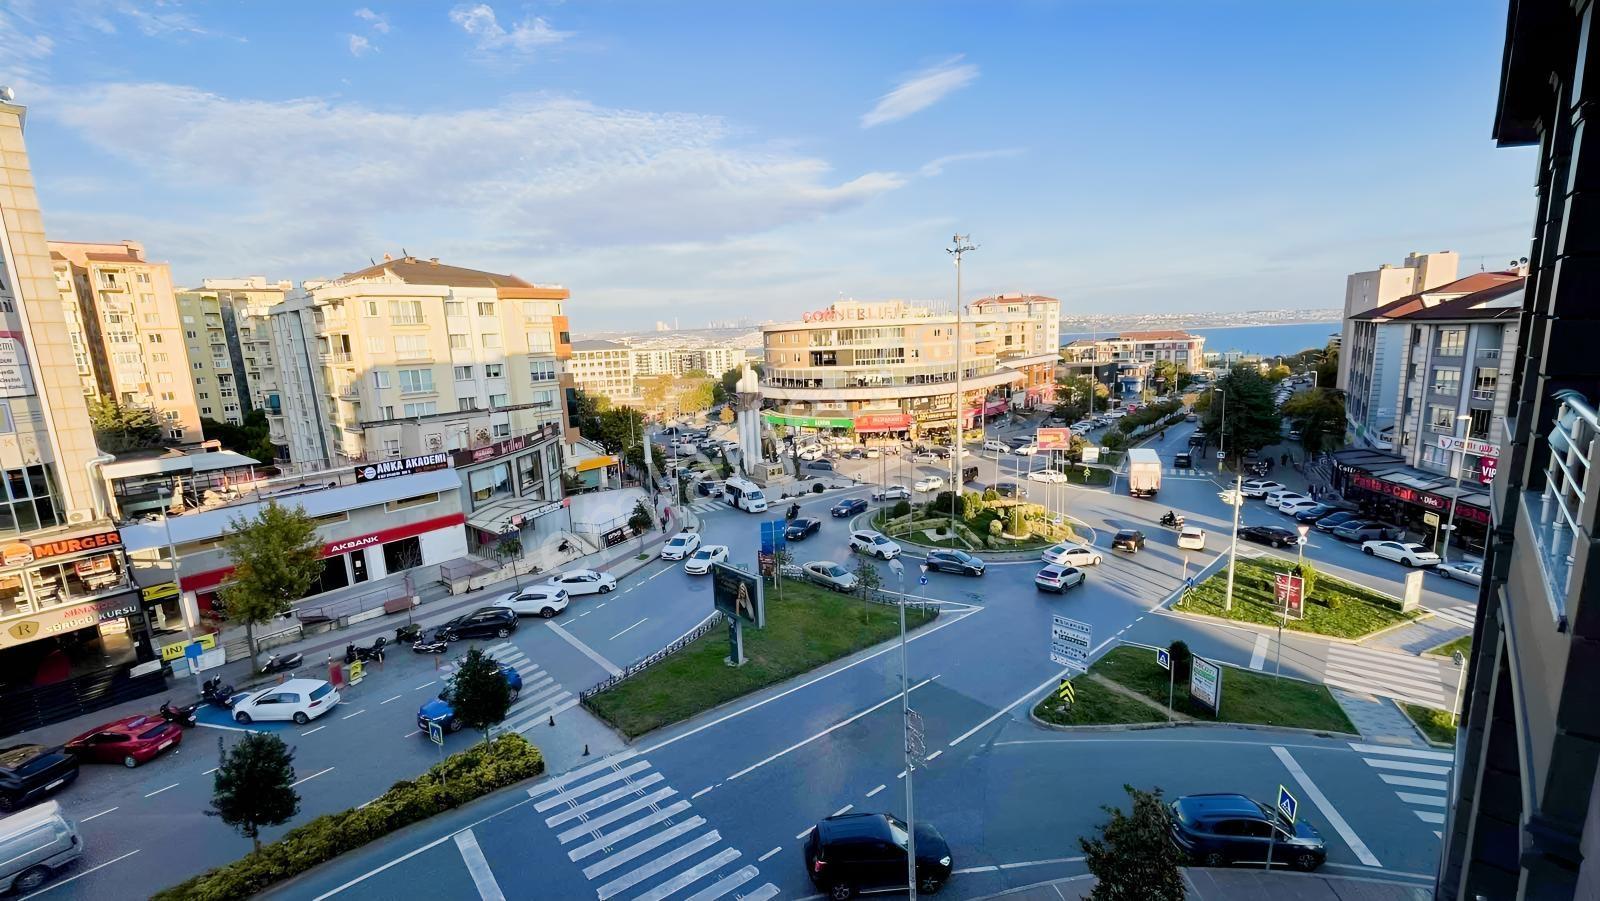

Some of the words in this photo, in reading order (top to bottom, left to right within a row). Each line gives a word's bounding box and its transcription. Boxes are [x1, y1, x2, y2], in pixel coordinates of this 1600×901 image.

[376, 461, 404, 475] ANKA
[1481, 465, 1497, 478] VIP
[34, 532, 120, 559] MURGER
[331, 535, 379, 553] AKBANK
[98, 604, 137, 621] KURSU
